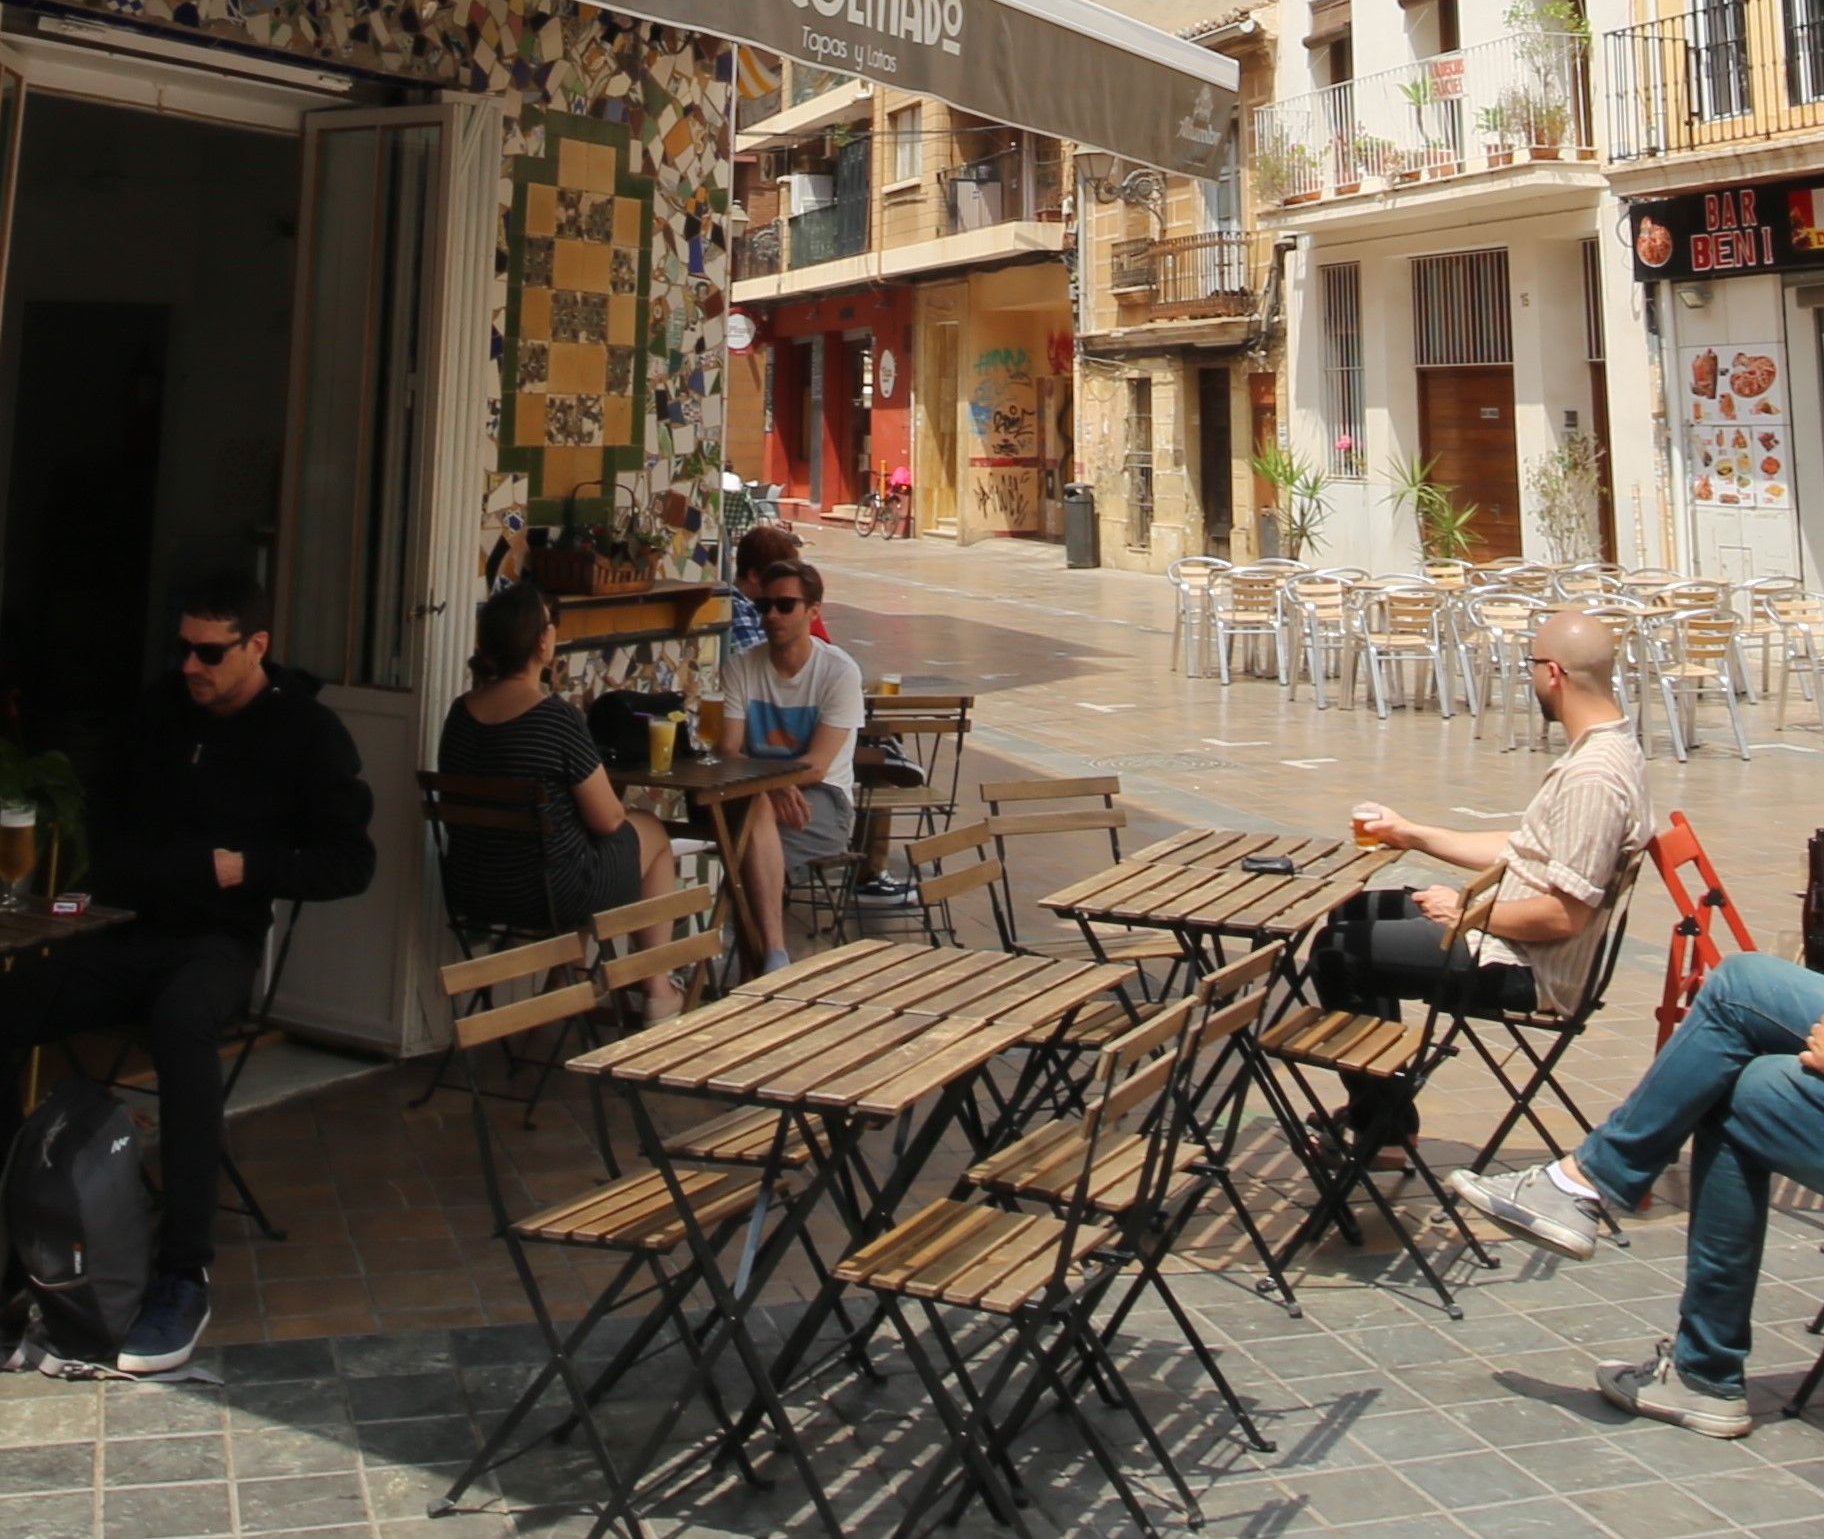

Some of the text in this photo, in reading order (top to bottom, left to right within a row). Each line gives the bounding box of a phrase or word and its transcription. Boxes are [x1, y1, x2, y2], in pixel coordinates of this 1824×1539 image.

[802, 25, 898, 73] Tapas y Latas
[1704, 189, 1757, 230] BAR
